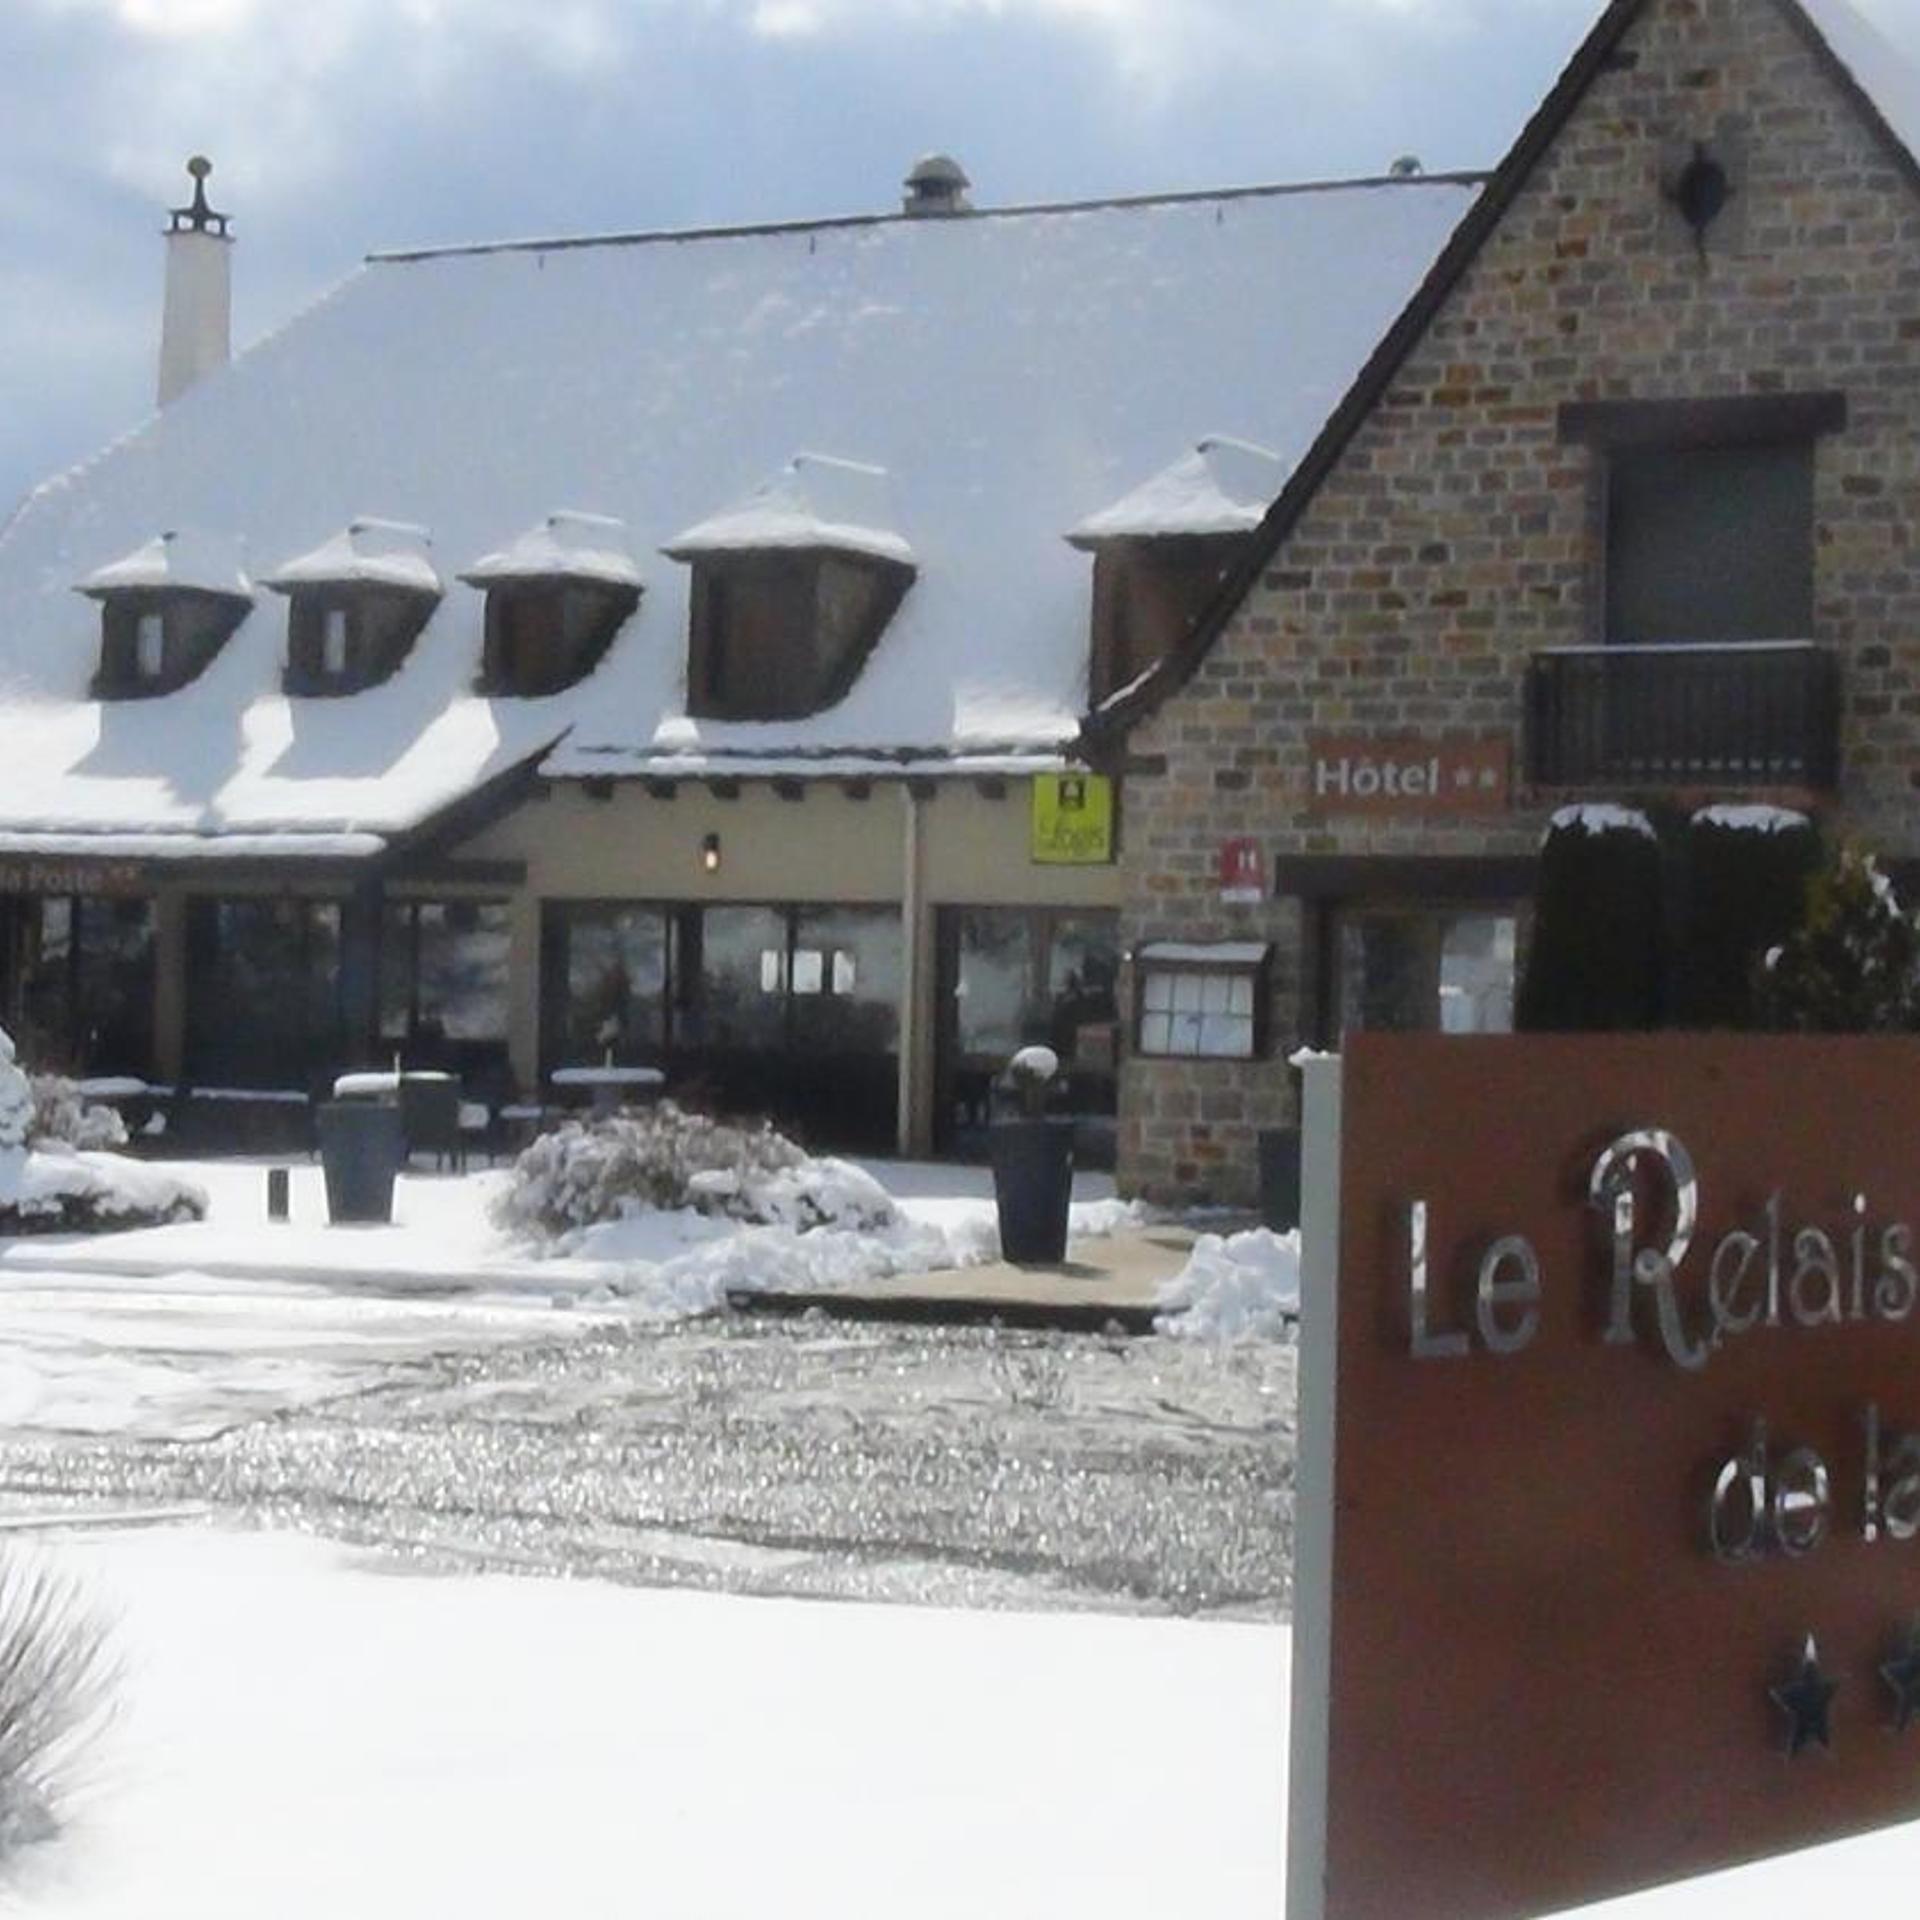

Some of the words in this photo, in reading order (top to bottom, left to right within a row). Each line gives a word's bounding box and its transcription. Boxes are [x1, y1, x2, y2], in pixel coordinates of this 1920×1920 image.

[1411, 1200, 1541, 1359] Le
[1590, 1128, 1918, 1371] Relais
[1711, 1415, 1829, 1567] de
